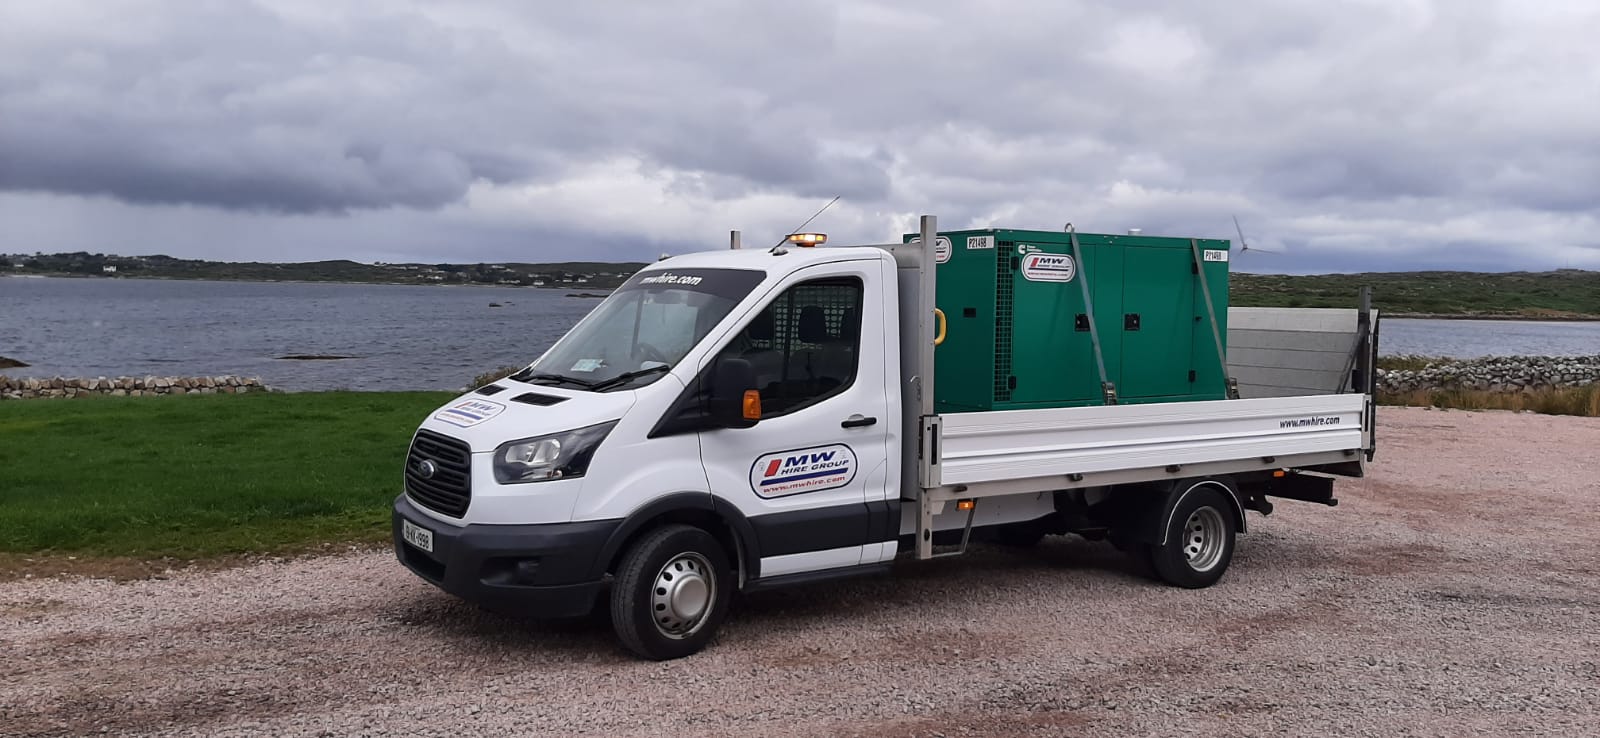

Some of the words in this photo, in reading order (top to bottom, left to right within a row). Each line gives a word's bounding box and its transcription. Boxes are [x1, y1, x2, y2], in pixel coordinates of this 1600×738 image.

[639, 272, 702, 285] mwhire.com
[1280, 416, 1340, 428] www.mwhire.com
[785, 451, 836, 467] MW
[781, 466, 808, 475] HIRE
[811, 460, 849, 470] GROUP
[763, 476, 845, 493] www.mwhire.com
